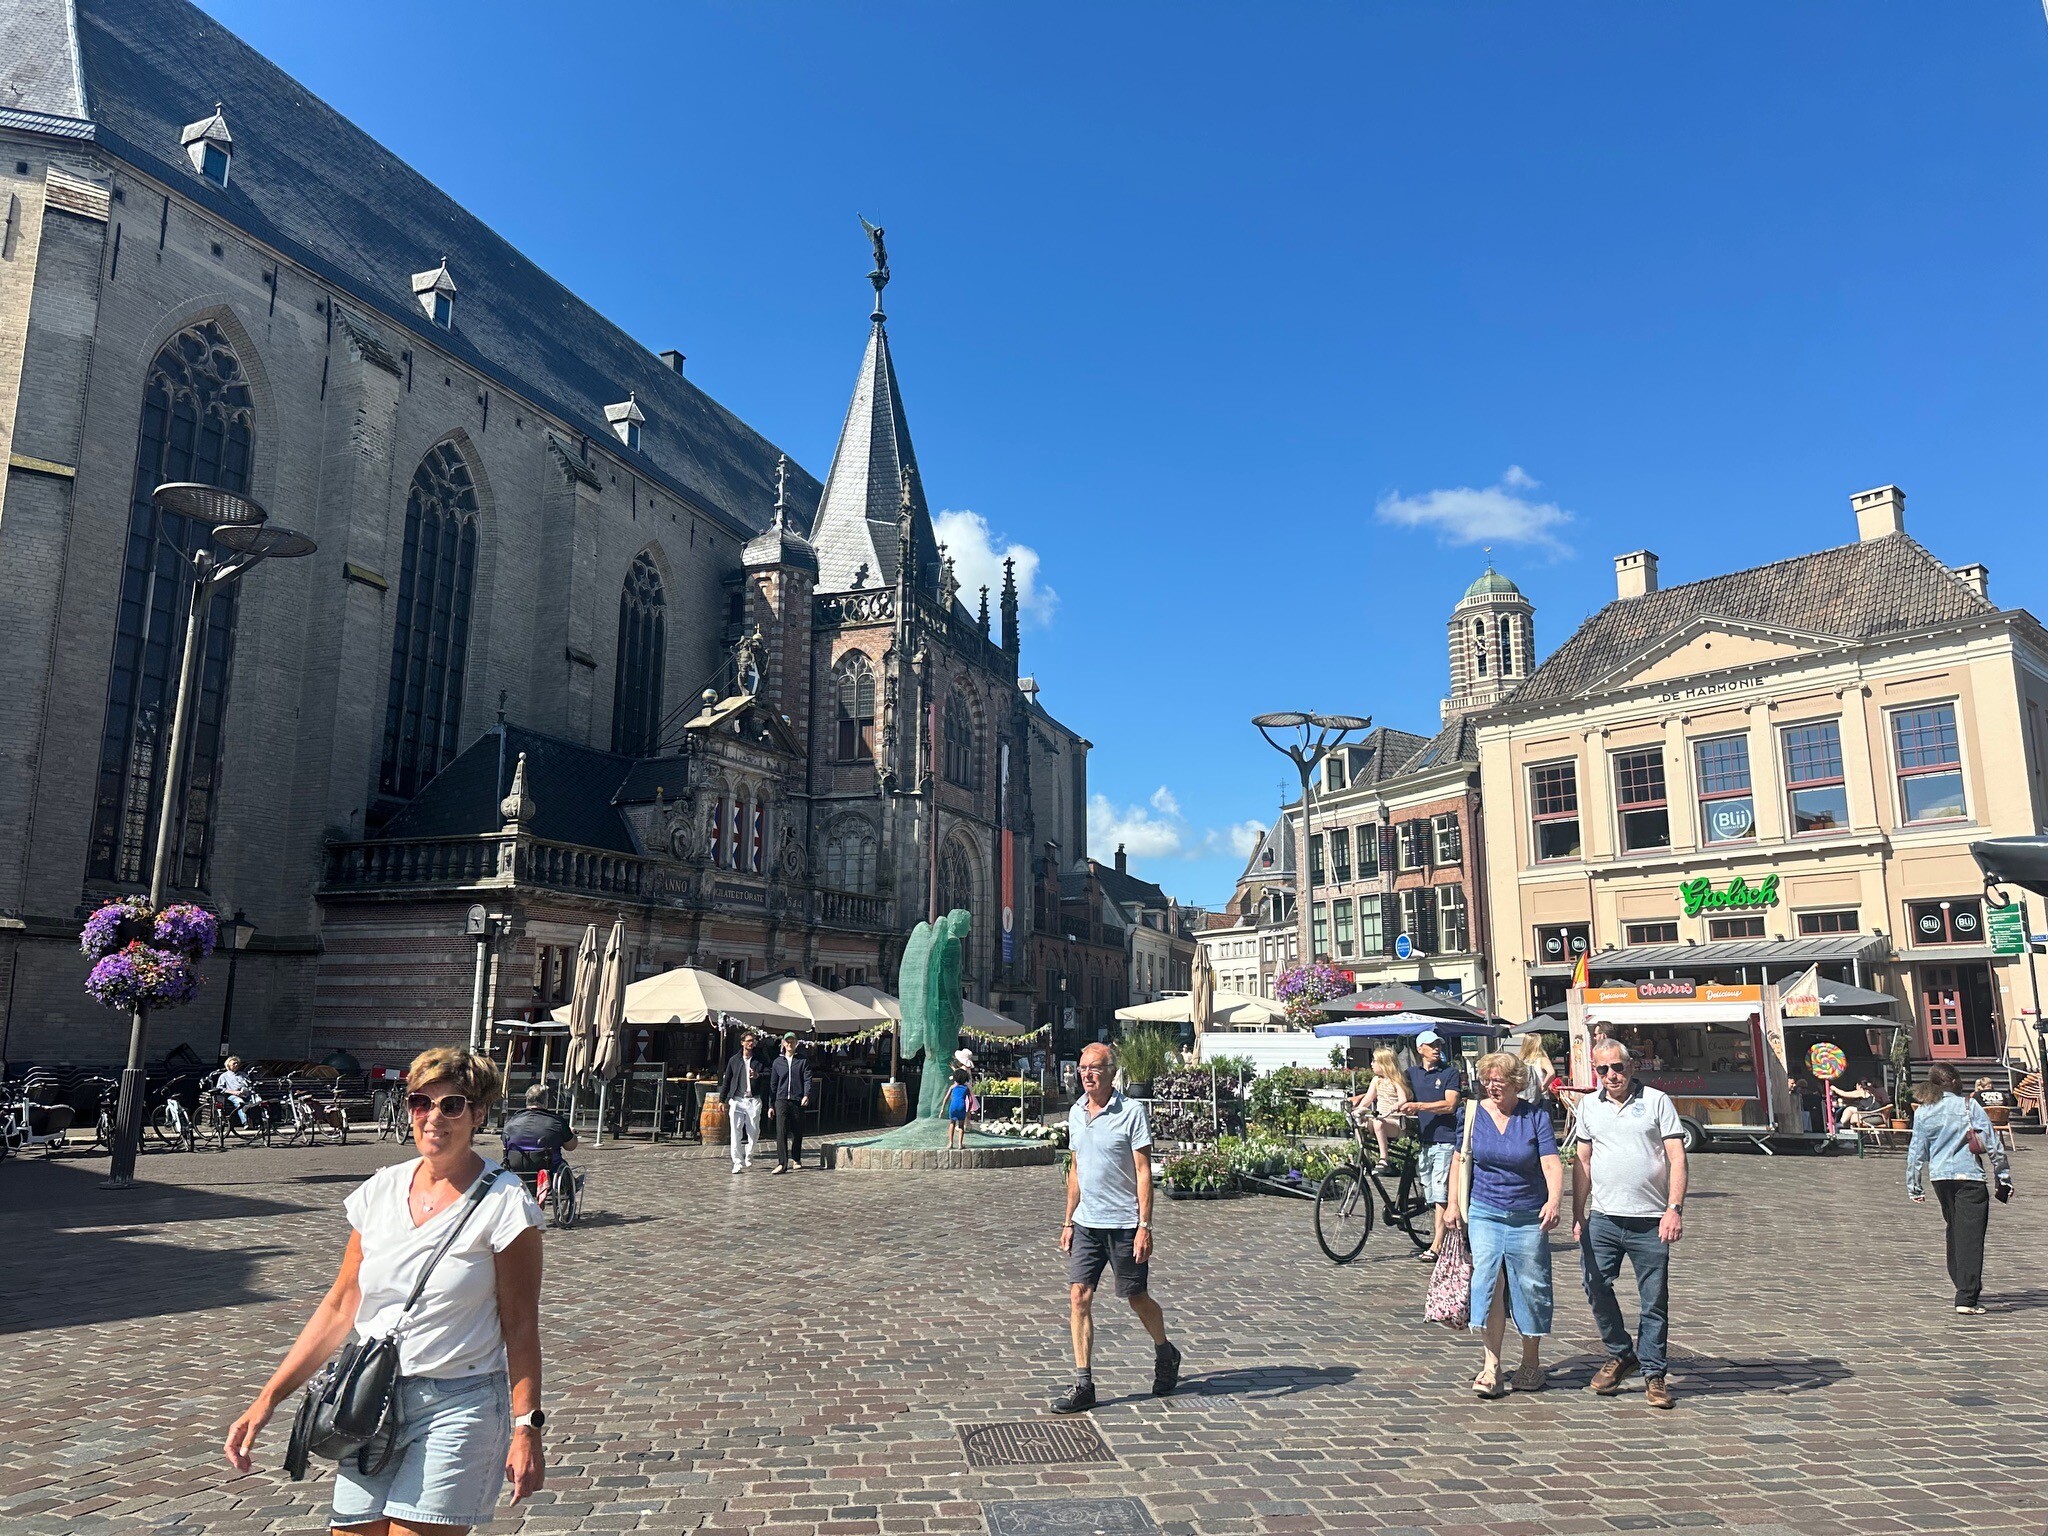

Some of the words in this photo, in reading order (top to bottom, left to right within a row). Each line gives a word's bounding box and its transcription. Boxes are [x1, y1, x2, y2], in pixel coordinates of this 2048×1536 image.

[1718, 810, 1746, 828] Blij
[1680, 874, 1778, 914] Grolsch
[1640, 983, 1693, 996] Churros
[1706, 990, 1742, 1000] Delicious
